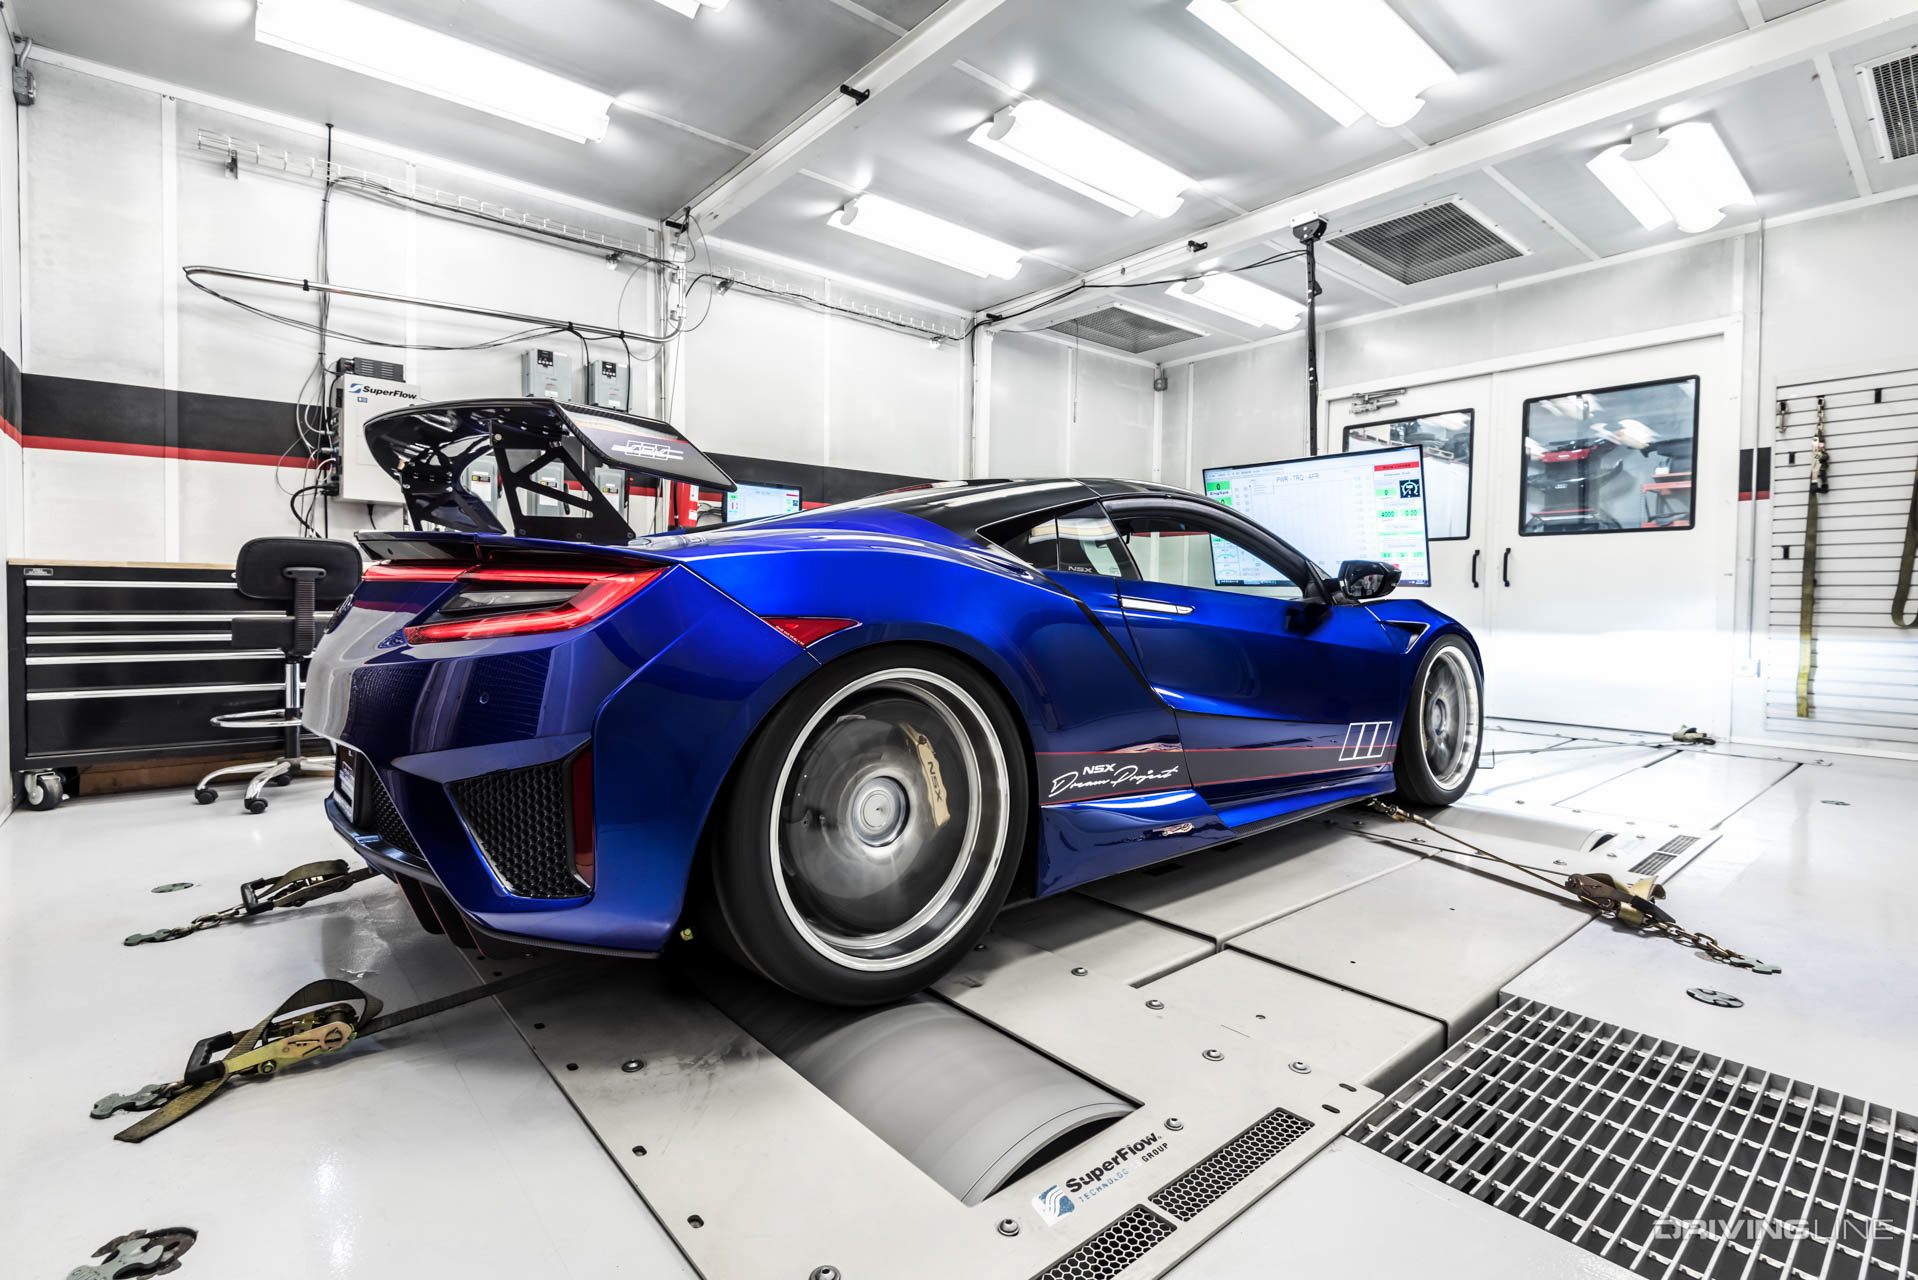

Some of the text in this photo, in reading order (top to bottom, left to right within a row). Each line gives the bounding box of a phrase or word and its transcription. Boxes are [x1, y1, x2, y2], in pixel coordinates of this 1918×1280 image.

[362, 385, 417, 399] SuperFlow
[928, 762, 942, 801] NSX
[1048, 765, 1179, 798] Dream Project
[1083, 763, 1117, 775] NSX
[1065, 1132, 1158, 1193] SuperFlow
[1141, 1142, 1168, 1162] GROUP
